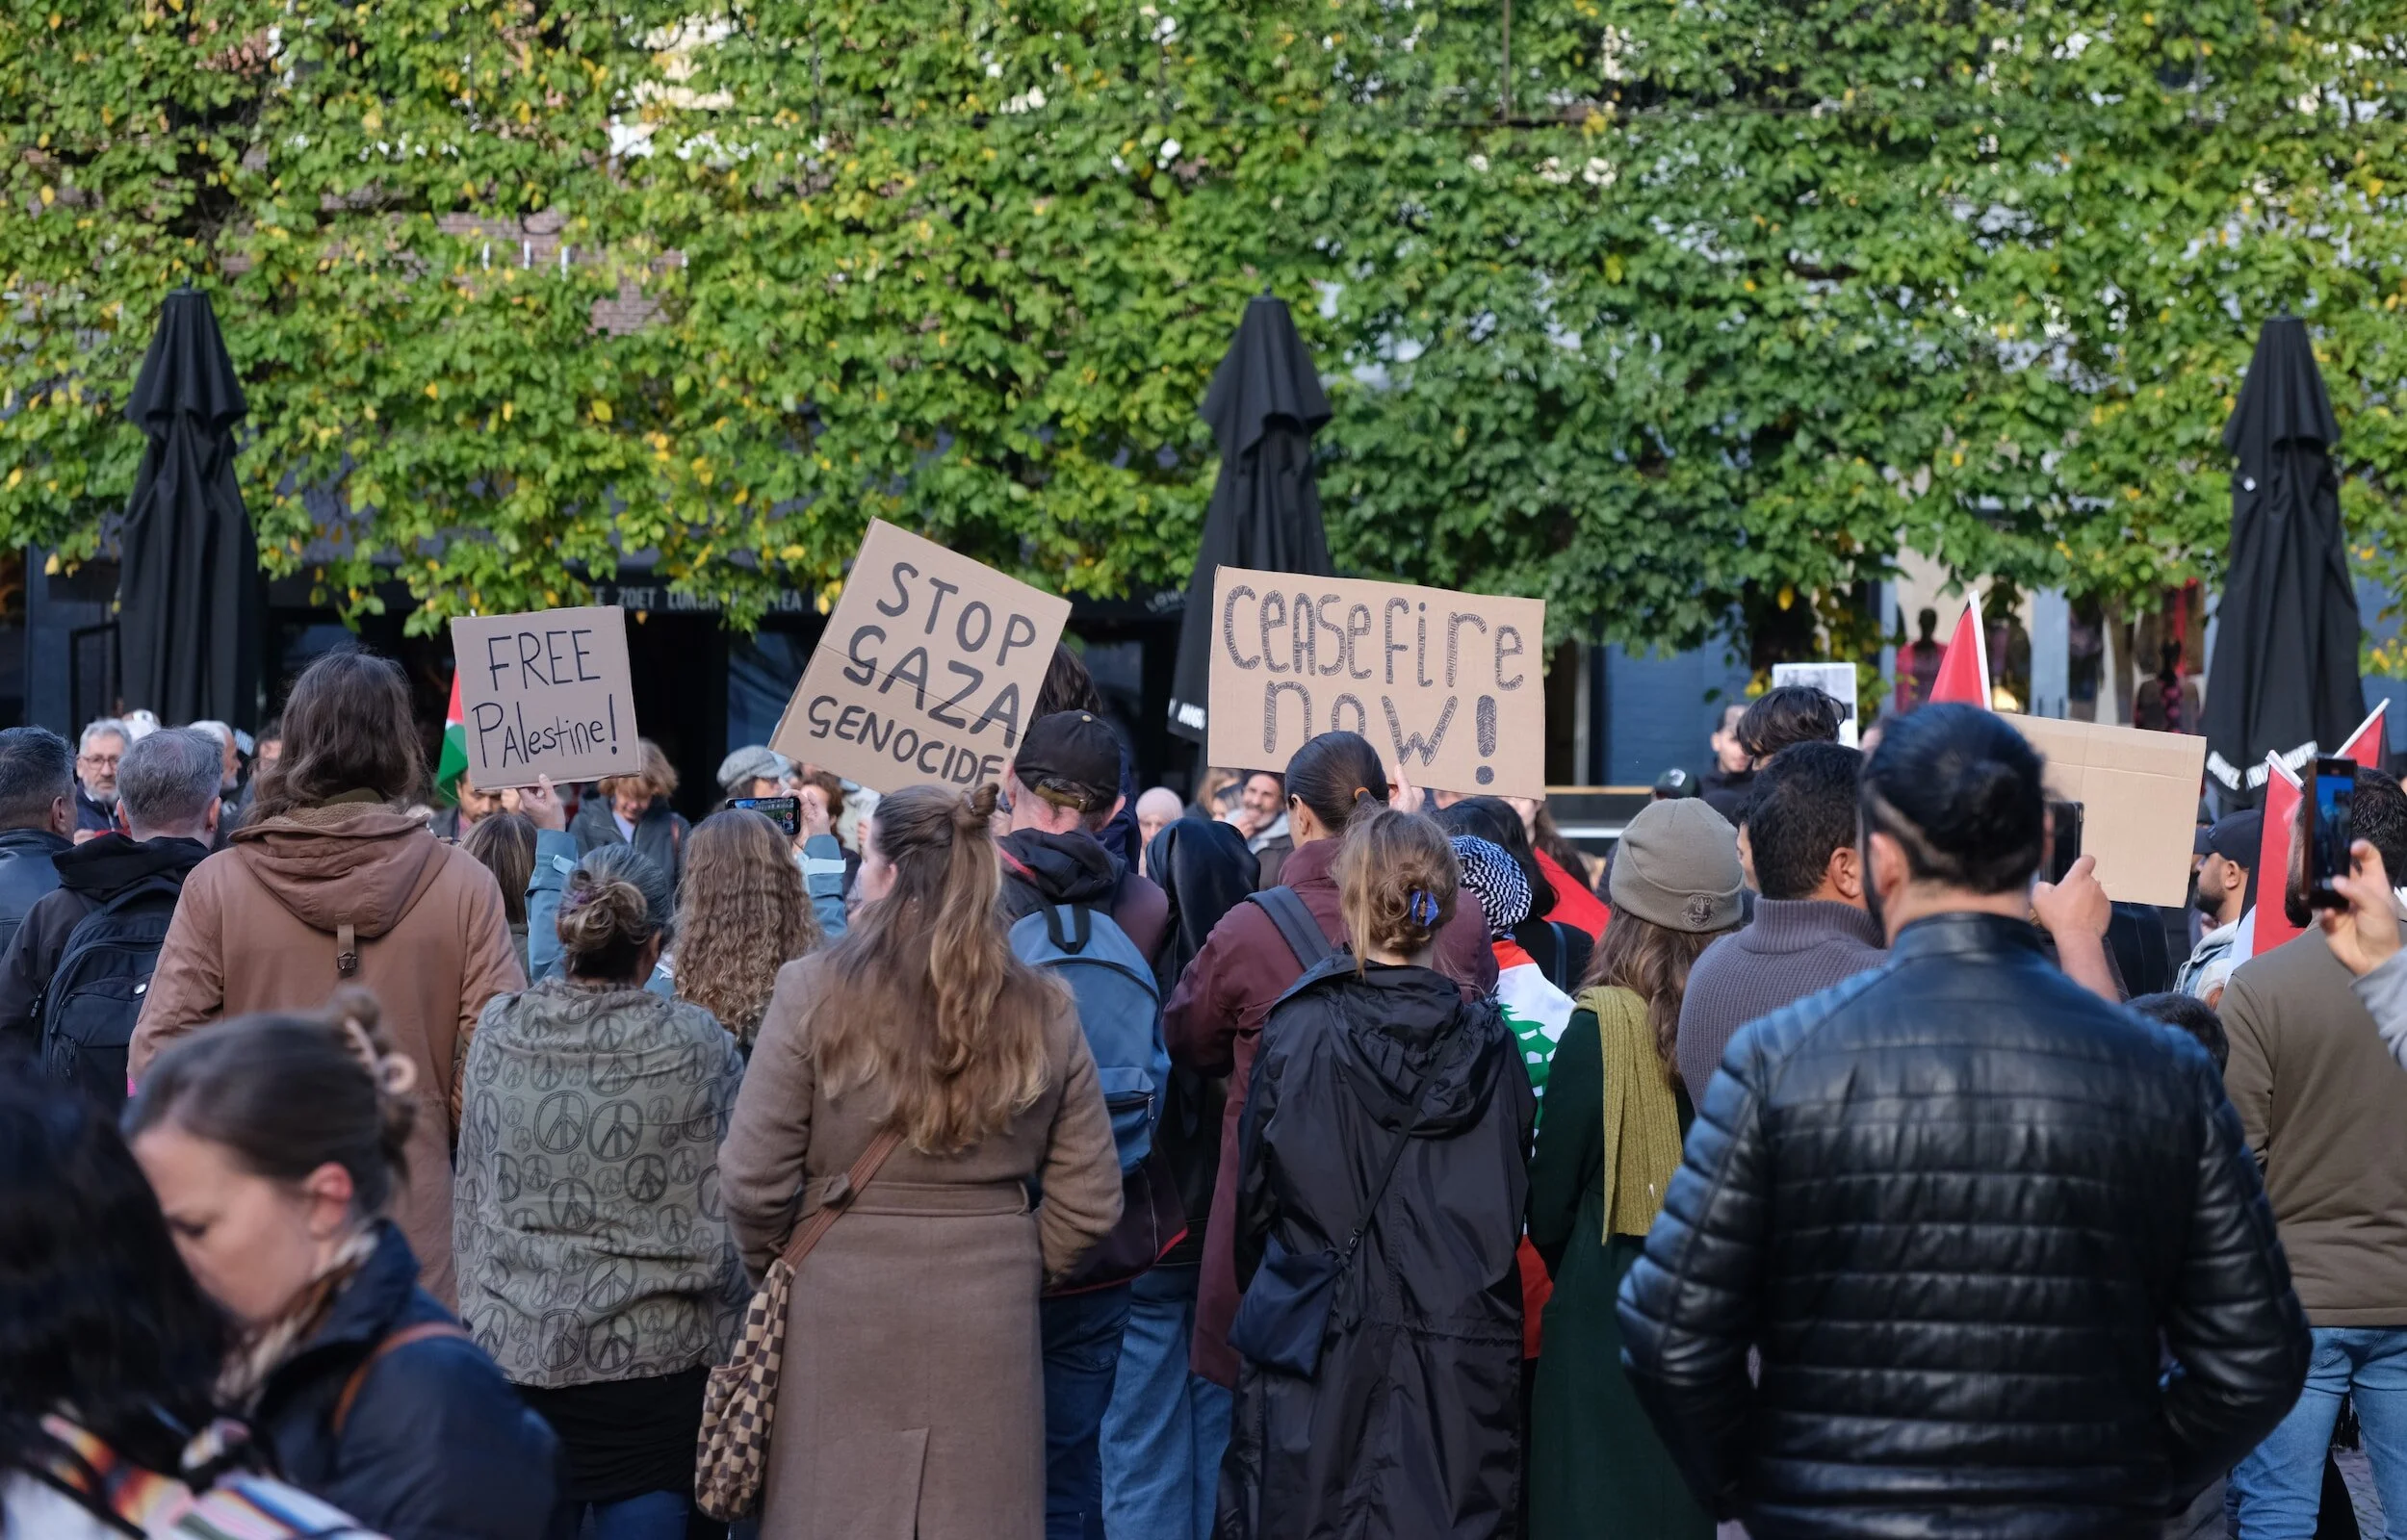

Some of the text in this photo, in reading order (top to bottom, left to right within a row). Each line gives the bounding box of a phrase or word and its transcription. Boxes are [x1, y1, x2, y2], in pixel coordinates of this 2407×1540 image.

[617, 585, 657, 609] ZOET
[876, 561, 1036, 667] STOP
[488, 629, 601, 691] FREE
[843, 625, 1021, 749] GAZA
[808, 695, 1005, 787] GENOCIDE
